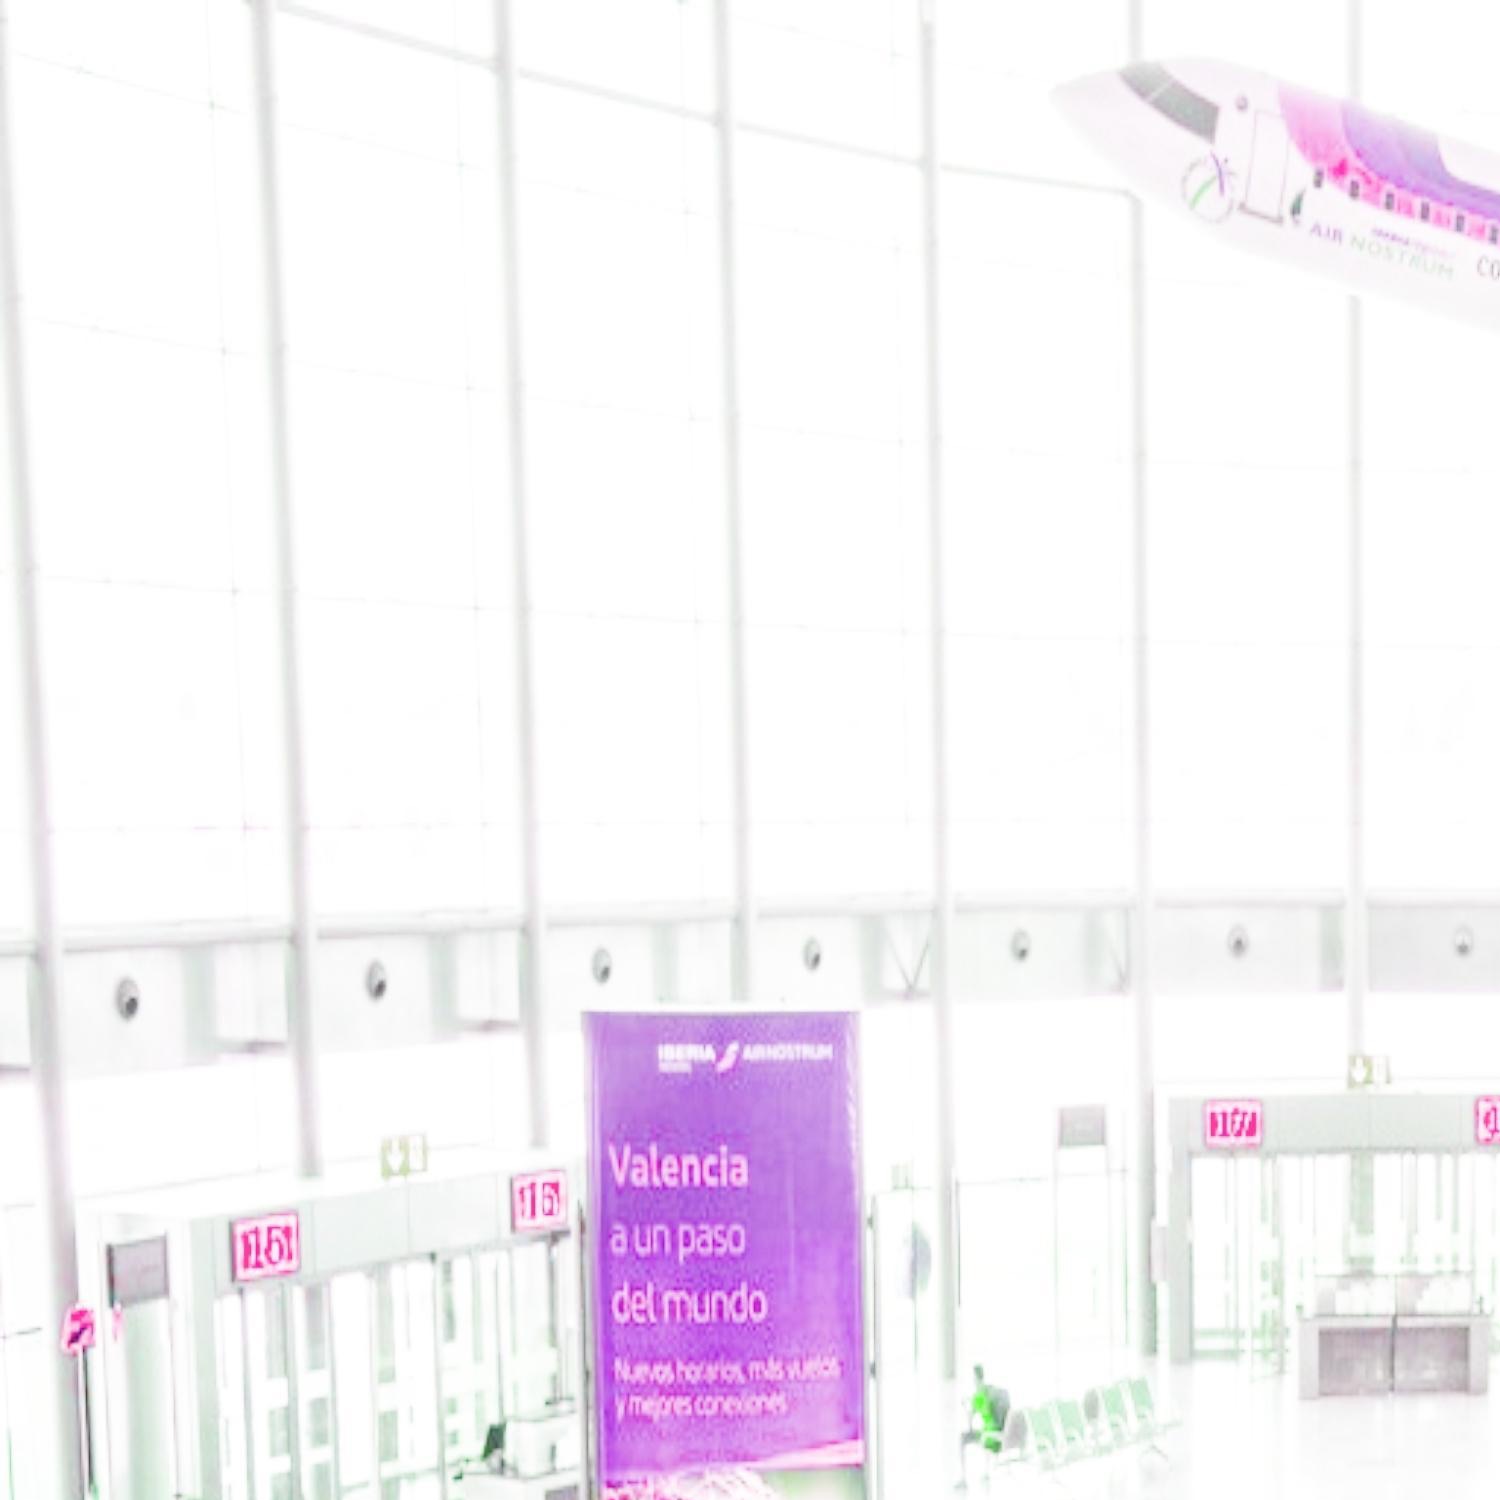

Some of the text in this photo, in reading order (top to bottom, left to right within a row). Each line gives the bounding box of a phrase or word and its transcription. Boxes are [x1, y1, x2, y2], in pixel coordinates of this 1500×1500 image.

[1211, 1110, 1254, 1137] 17
[608, 1143, 749, 1187] Valencia
[519, 1182, 561, 1220] 16
[611, 1223, 746, 1265] a un paso
[612, 1280, 768, 1323] del mundo
[615, 1357, 675, 1384] Nuevos
[615, 1393, 627, 1421] y
